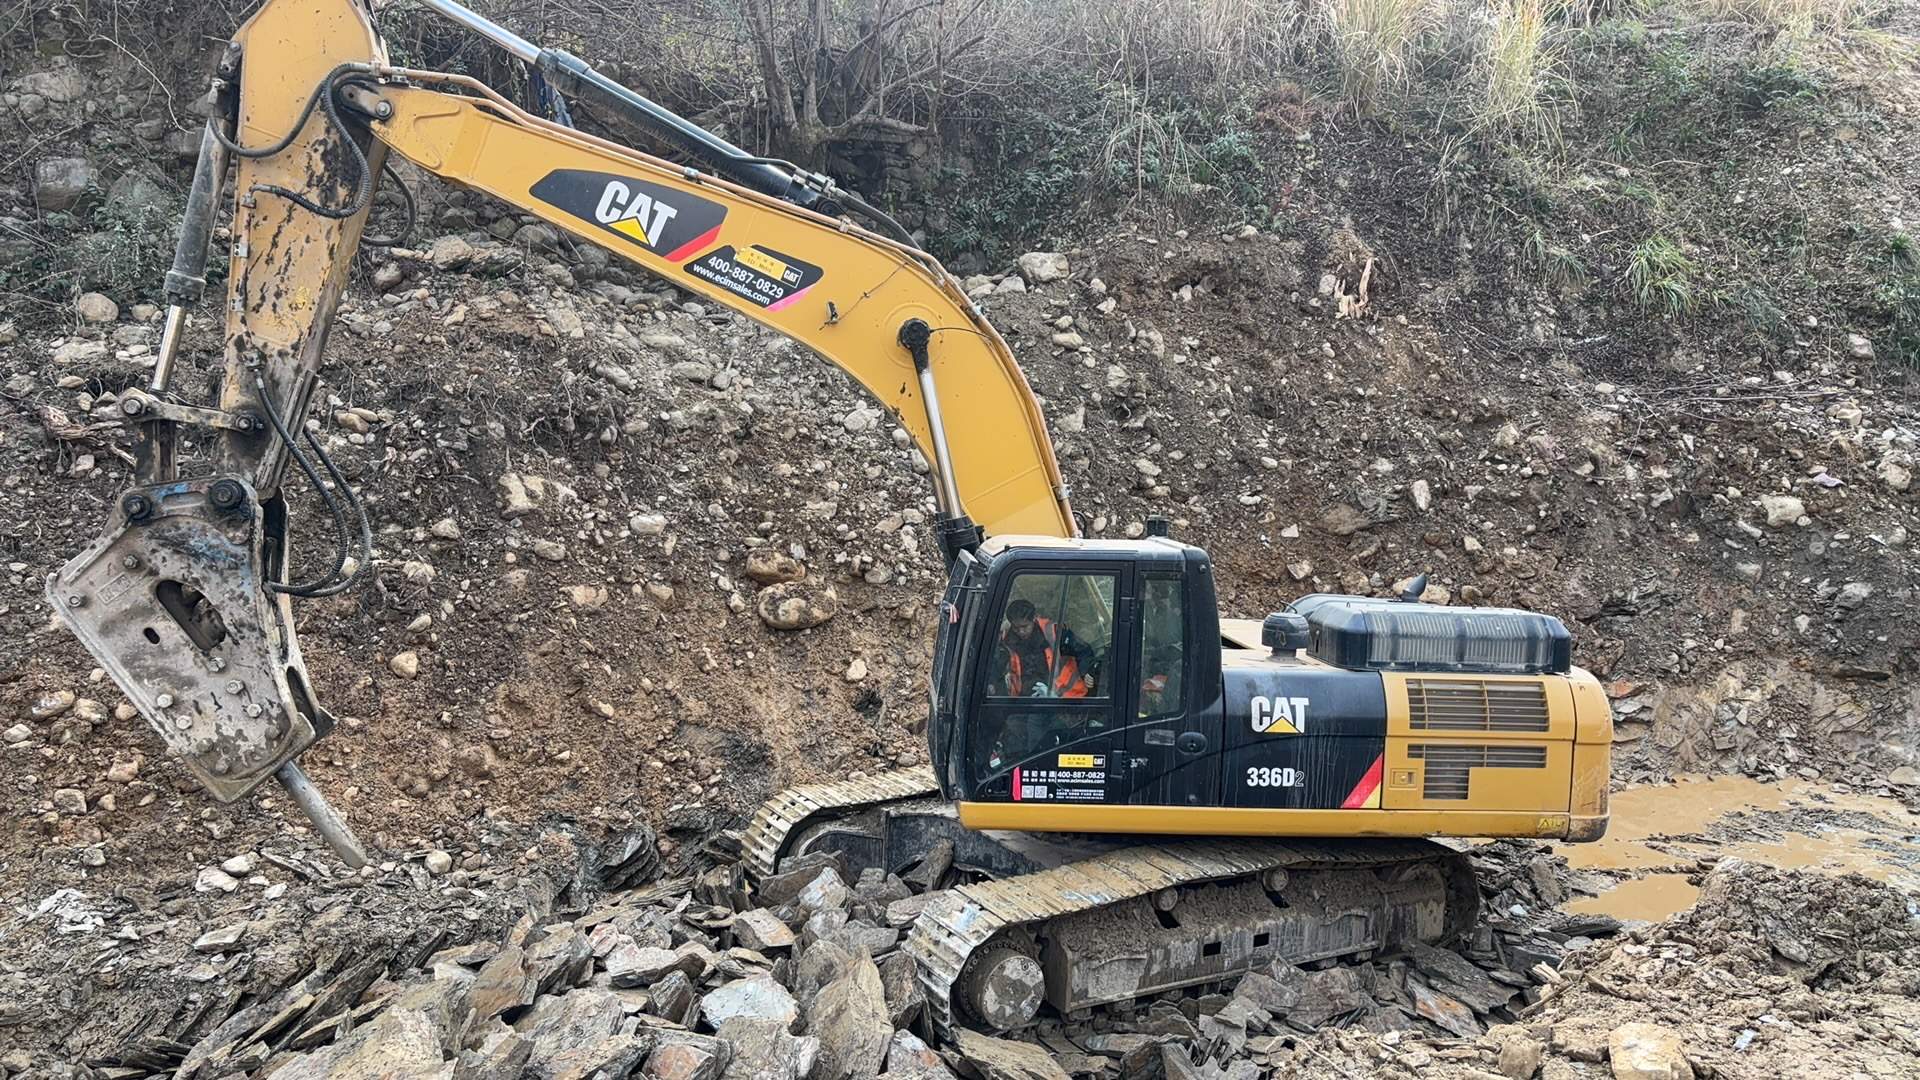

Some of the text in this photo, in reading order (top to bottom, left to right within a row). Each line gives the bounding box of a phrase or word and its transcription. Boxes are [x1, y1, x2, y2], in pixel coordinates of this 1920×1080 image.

[595, 180, 678, 247] CAT
[693, 264, 770, 305] www.ecimsales.com
[708, 256, 784, 299] 400-887-0829
[783, 269, 799, 283] CAT
[1251, 695, 1310, 734] CAT
[1057, 771, 1105, 779] 400-887-0829
[1246, 767, 1305, 788] 336D2
